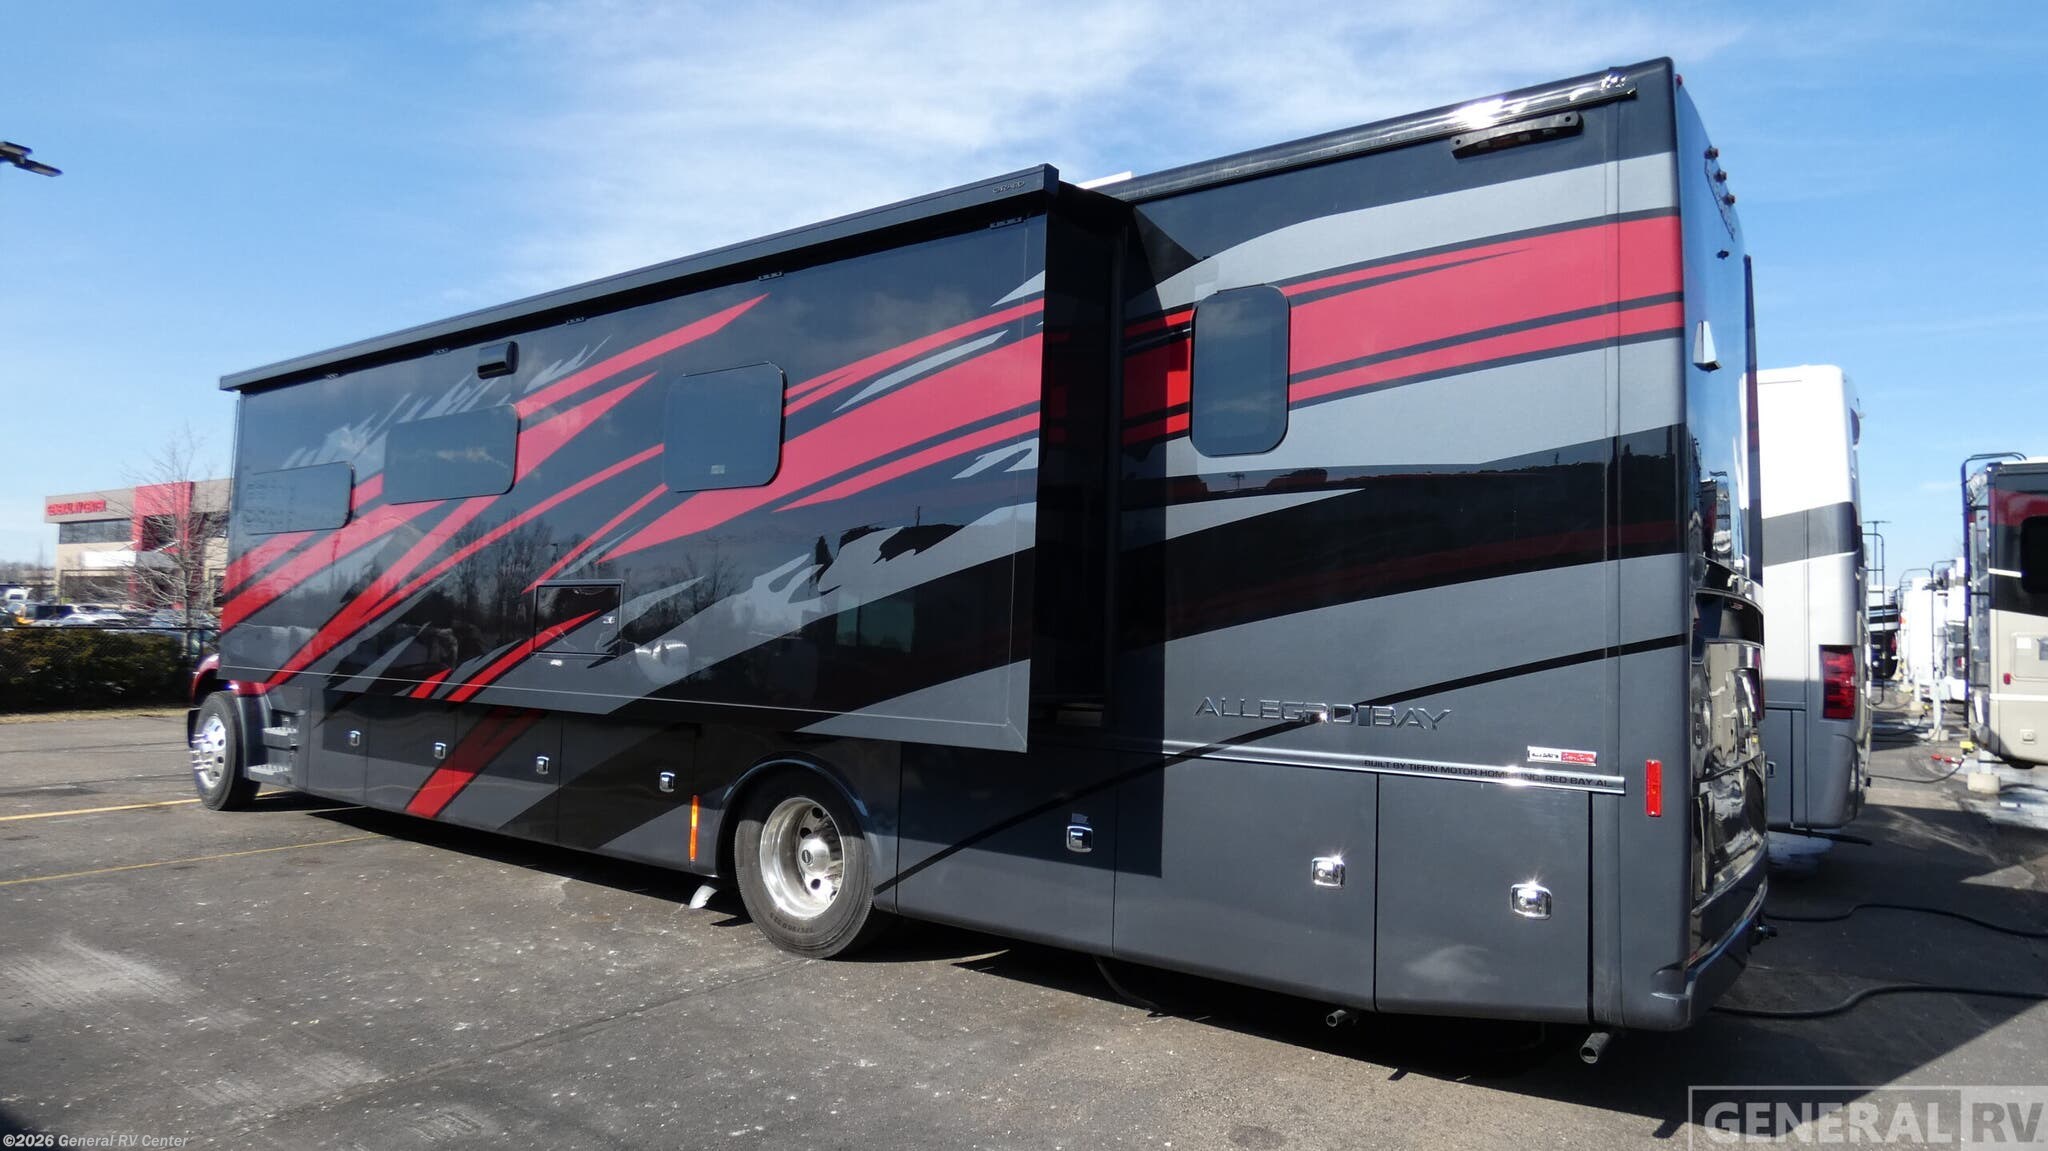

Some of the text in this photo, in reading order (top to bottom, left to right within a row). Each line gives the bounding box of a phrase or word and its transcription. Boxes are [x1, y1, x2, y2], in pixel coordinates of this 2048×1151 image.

[1195, 696, 1452, 730] ALLEGRO BAY
[1364, 759, 1390, 769] BUILT
[1392, 762, 1407, 770] BY
[1409, 763, 1439, 773] TIFFIN
[1440, 766, 1478, 776] MOTOR
[1480, 768, 1520, 779] HOME
[1545, 775, 1567, 784] RED
[1570, 777, 1593, 785] BAY
